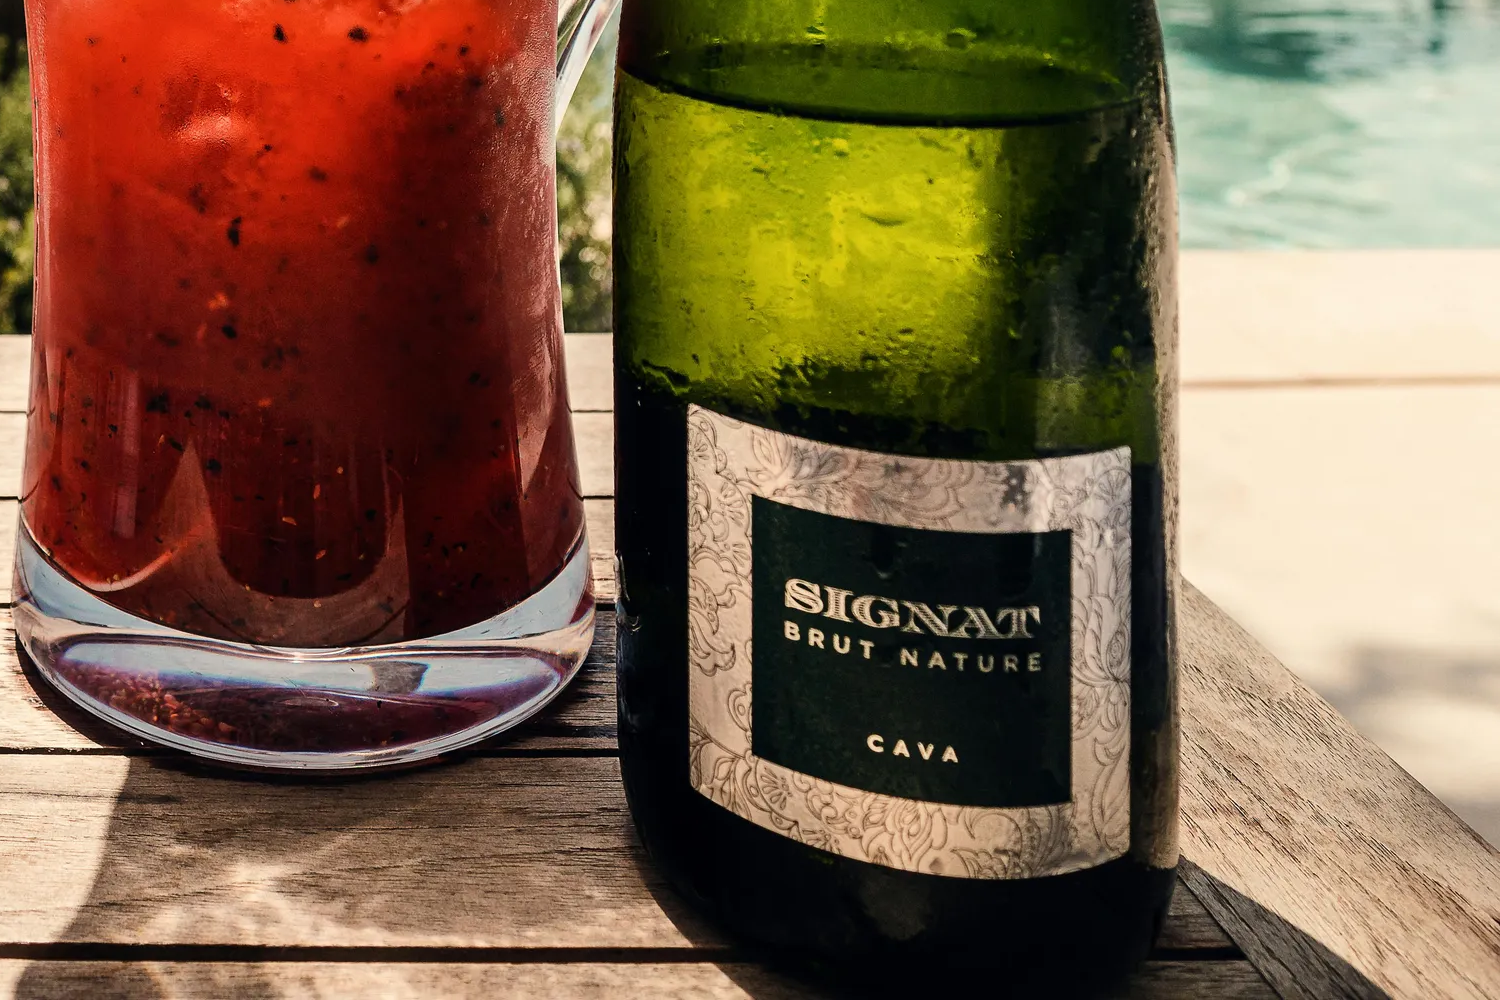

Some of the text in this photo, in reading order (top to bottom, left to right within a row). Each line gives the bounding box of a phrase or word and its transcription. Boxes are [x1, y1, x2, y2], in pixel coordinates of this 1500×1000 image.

[784, 577, 1041, 639] SIGNAT
[783, 620, 1043, 673] BRUT NATURE
[866, 733, 959, 764] CAVA
